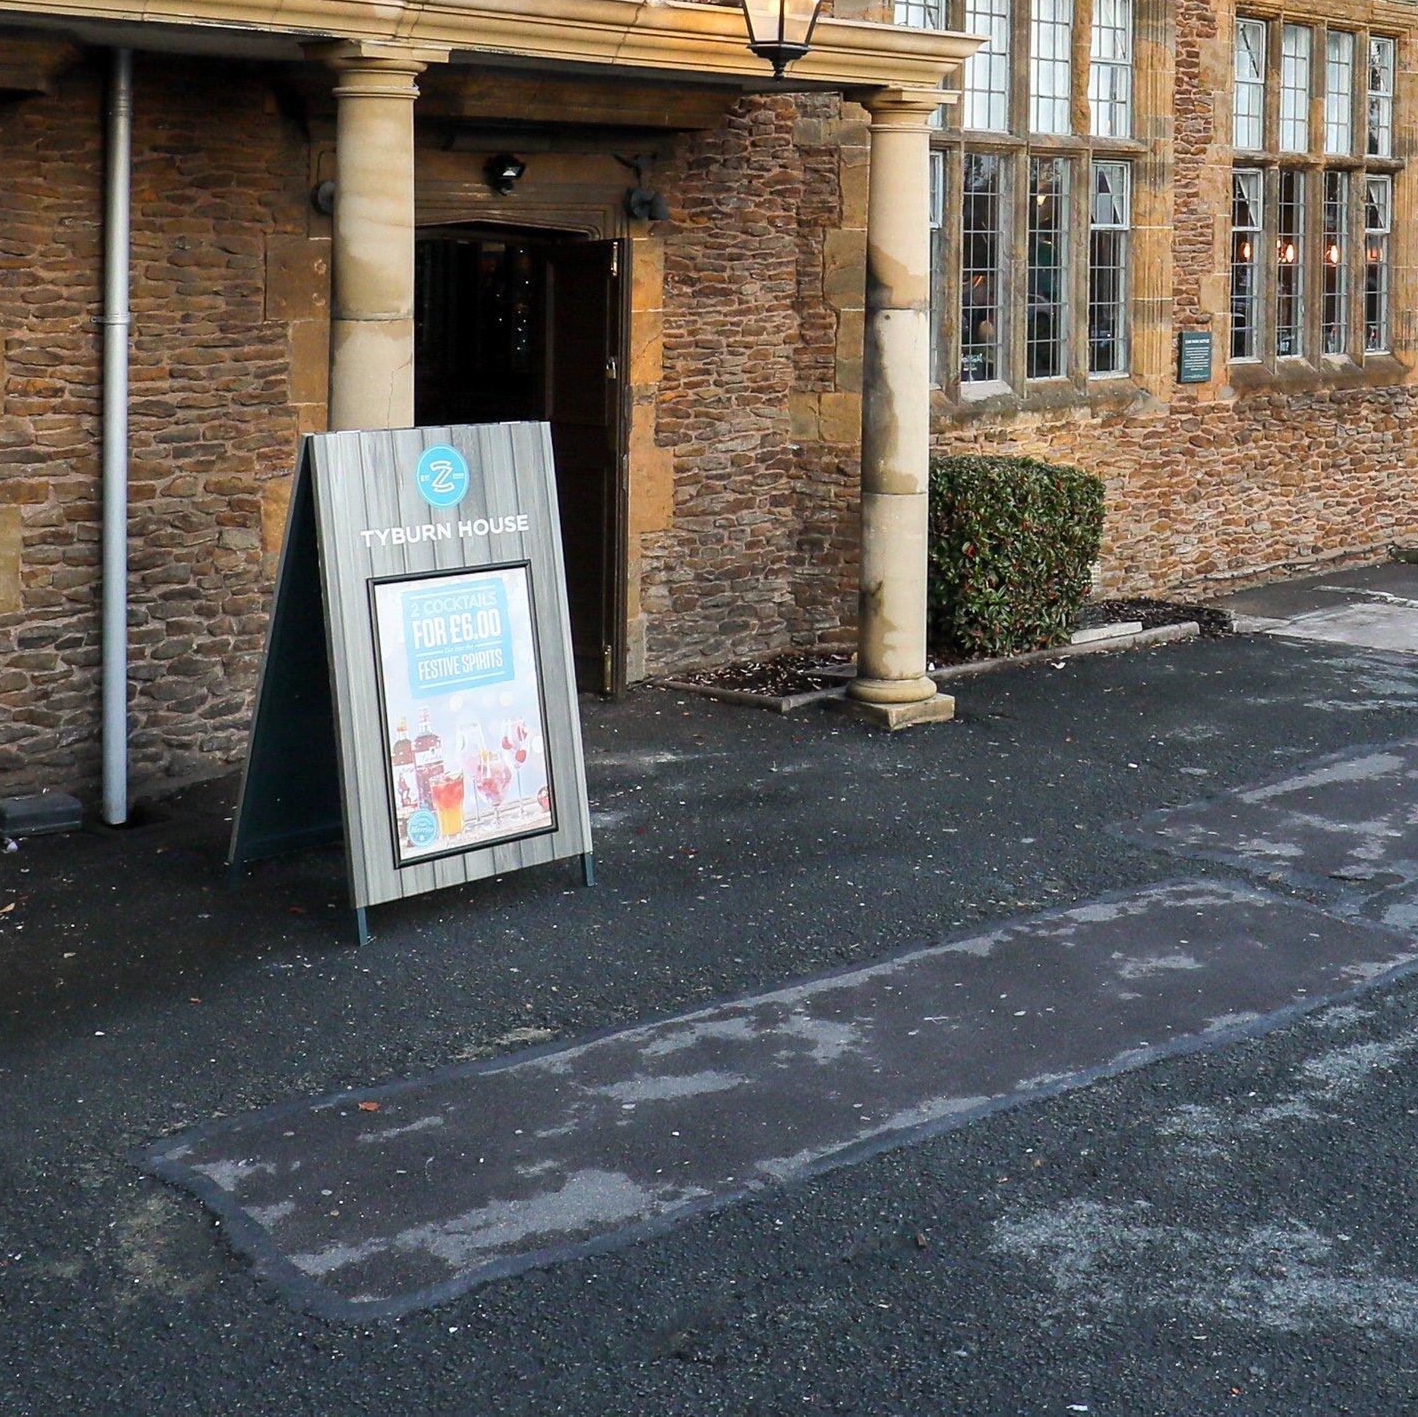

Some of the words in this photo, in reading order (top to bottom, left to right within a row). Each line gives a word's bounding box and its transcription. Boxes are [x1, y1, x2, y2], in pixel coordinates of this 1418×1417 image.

[360, 522, 452, 548] TYBURN
[457, 514, 530, 538] HOUSE
[410, 602, 421, 618] 2
[423, 591, 497, 615] COCKTAILS
[412, 617, 448, 650] FOR
[449, 608, 503, 644] £6.00
[418, 655, 461, 681] FESTIVE
[461, 648, 504, 673] SPIRITS
